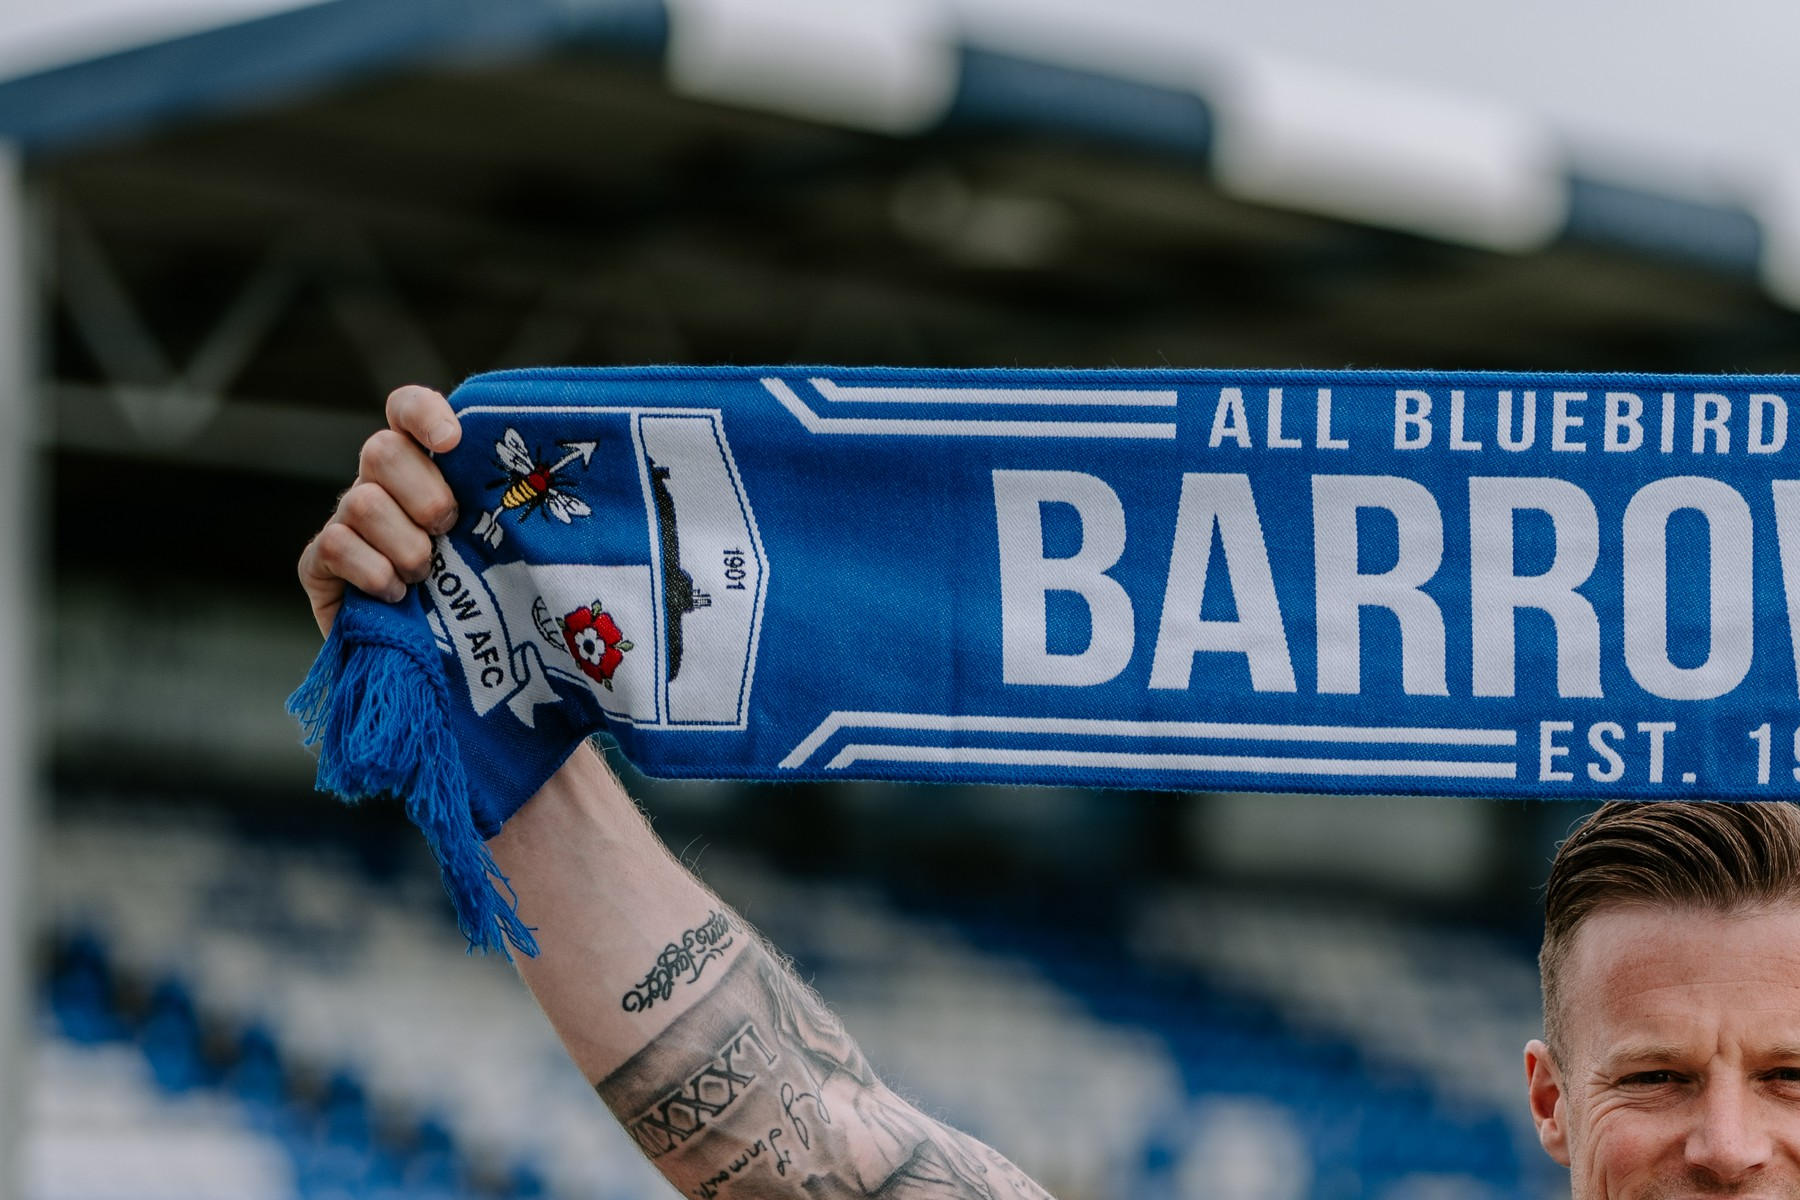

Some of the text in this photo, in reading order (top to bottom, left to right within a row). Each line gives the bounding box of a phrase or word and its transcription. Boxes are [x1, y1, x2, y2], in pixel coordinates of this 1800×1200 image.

[1208, 386, 1350, 450] ALL
[722, 546, 745, 591] 1901
[464, 630, 504, 688] AFC
[1538, 720, 1698, 784] EST.
